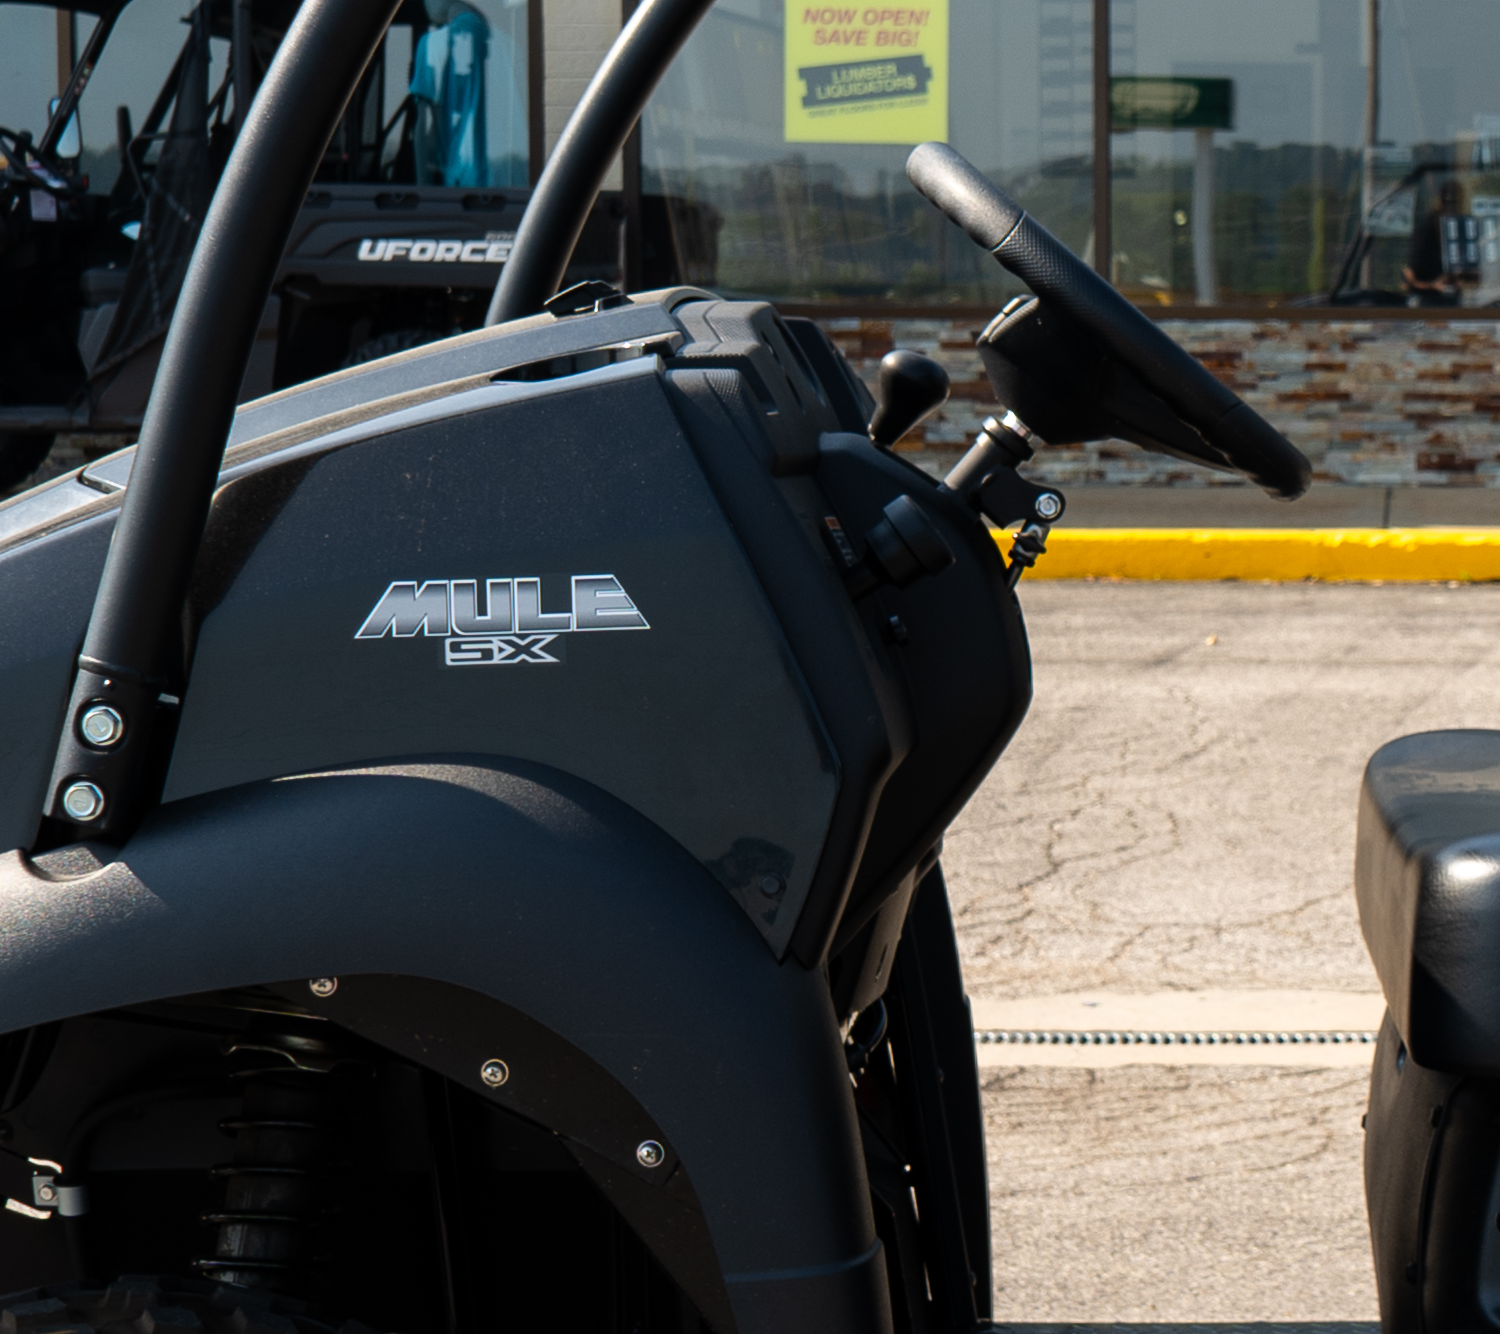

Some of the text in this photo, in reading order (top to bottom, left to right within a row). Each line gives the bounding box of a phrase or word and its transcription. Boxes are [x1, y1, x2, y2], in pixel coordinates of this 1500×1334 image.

[802, 8, 931, 27] NOW OPEN!
[813, 28, 921, 47] SAVE BIG!
[358, 239, 514, 263] UFORCE
[353, 573, 651, 639] MULE
[444, 634, 561, 666] SX
